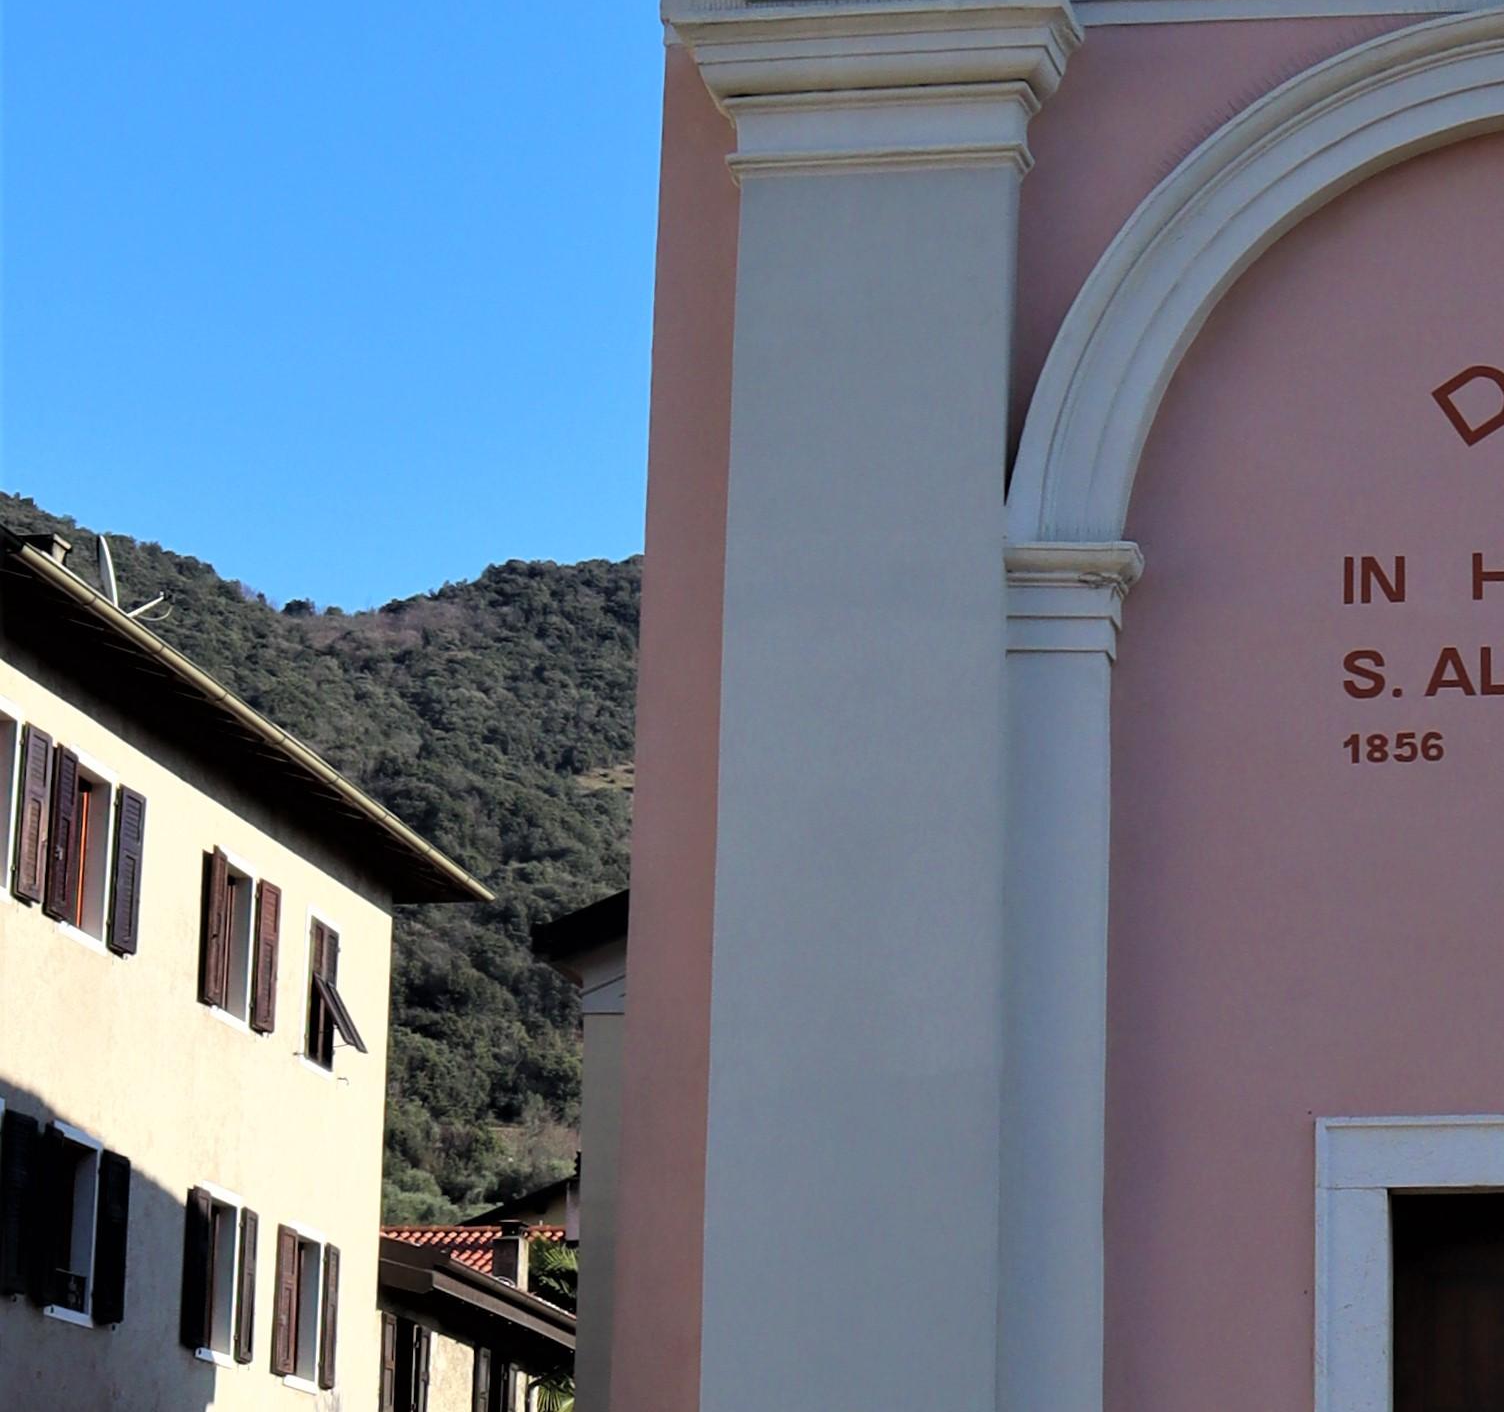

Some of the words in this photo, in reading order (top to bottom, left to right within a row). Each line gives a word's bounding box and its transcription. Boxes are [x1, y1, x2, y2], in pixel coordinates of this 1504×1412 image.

[1343, 555, 1406, 605] IN
[1342, 649, 1403, 699] S.
[1342, 731, 1445, 764] 1856
